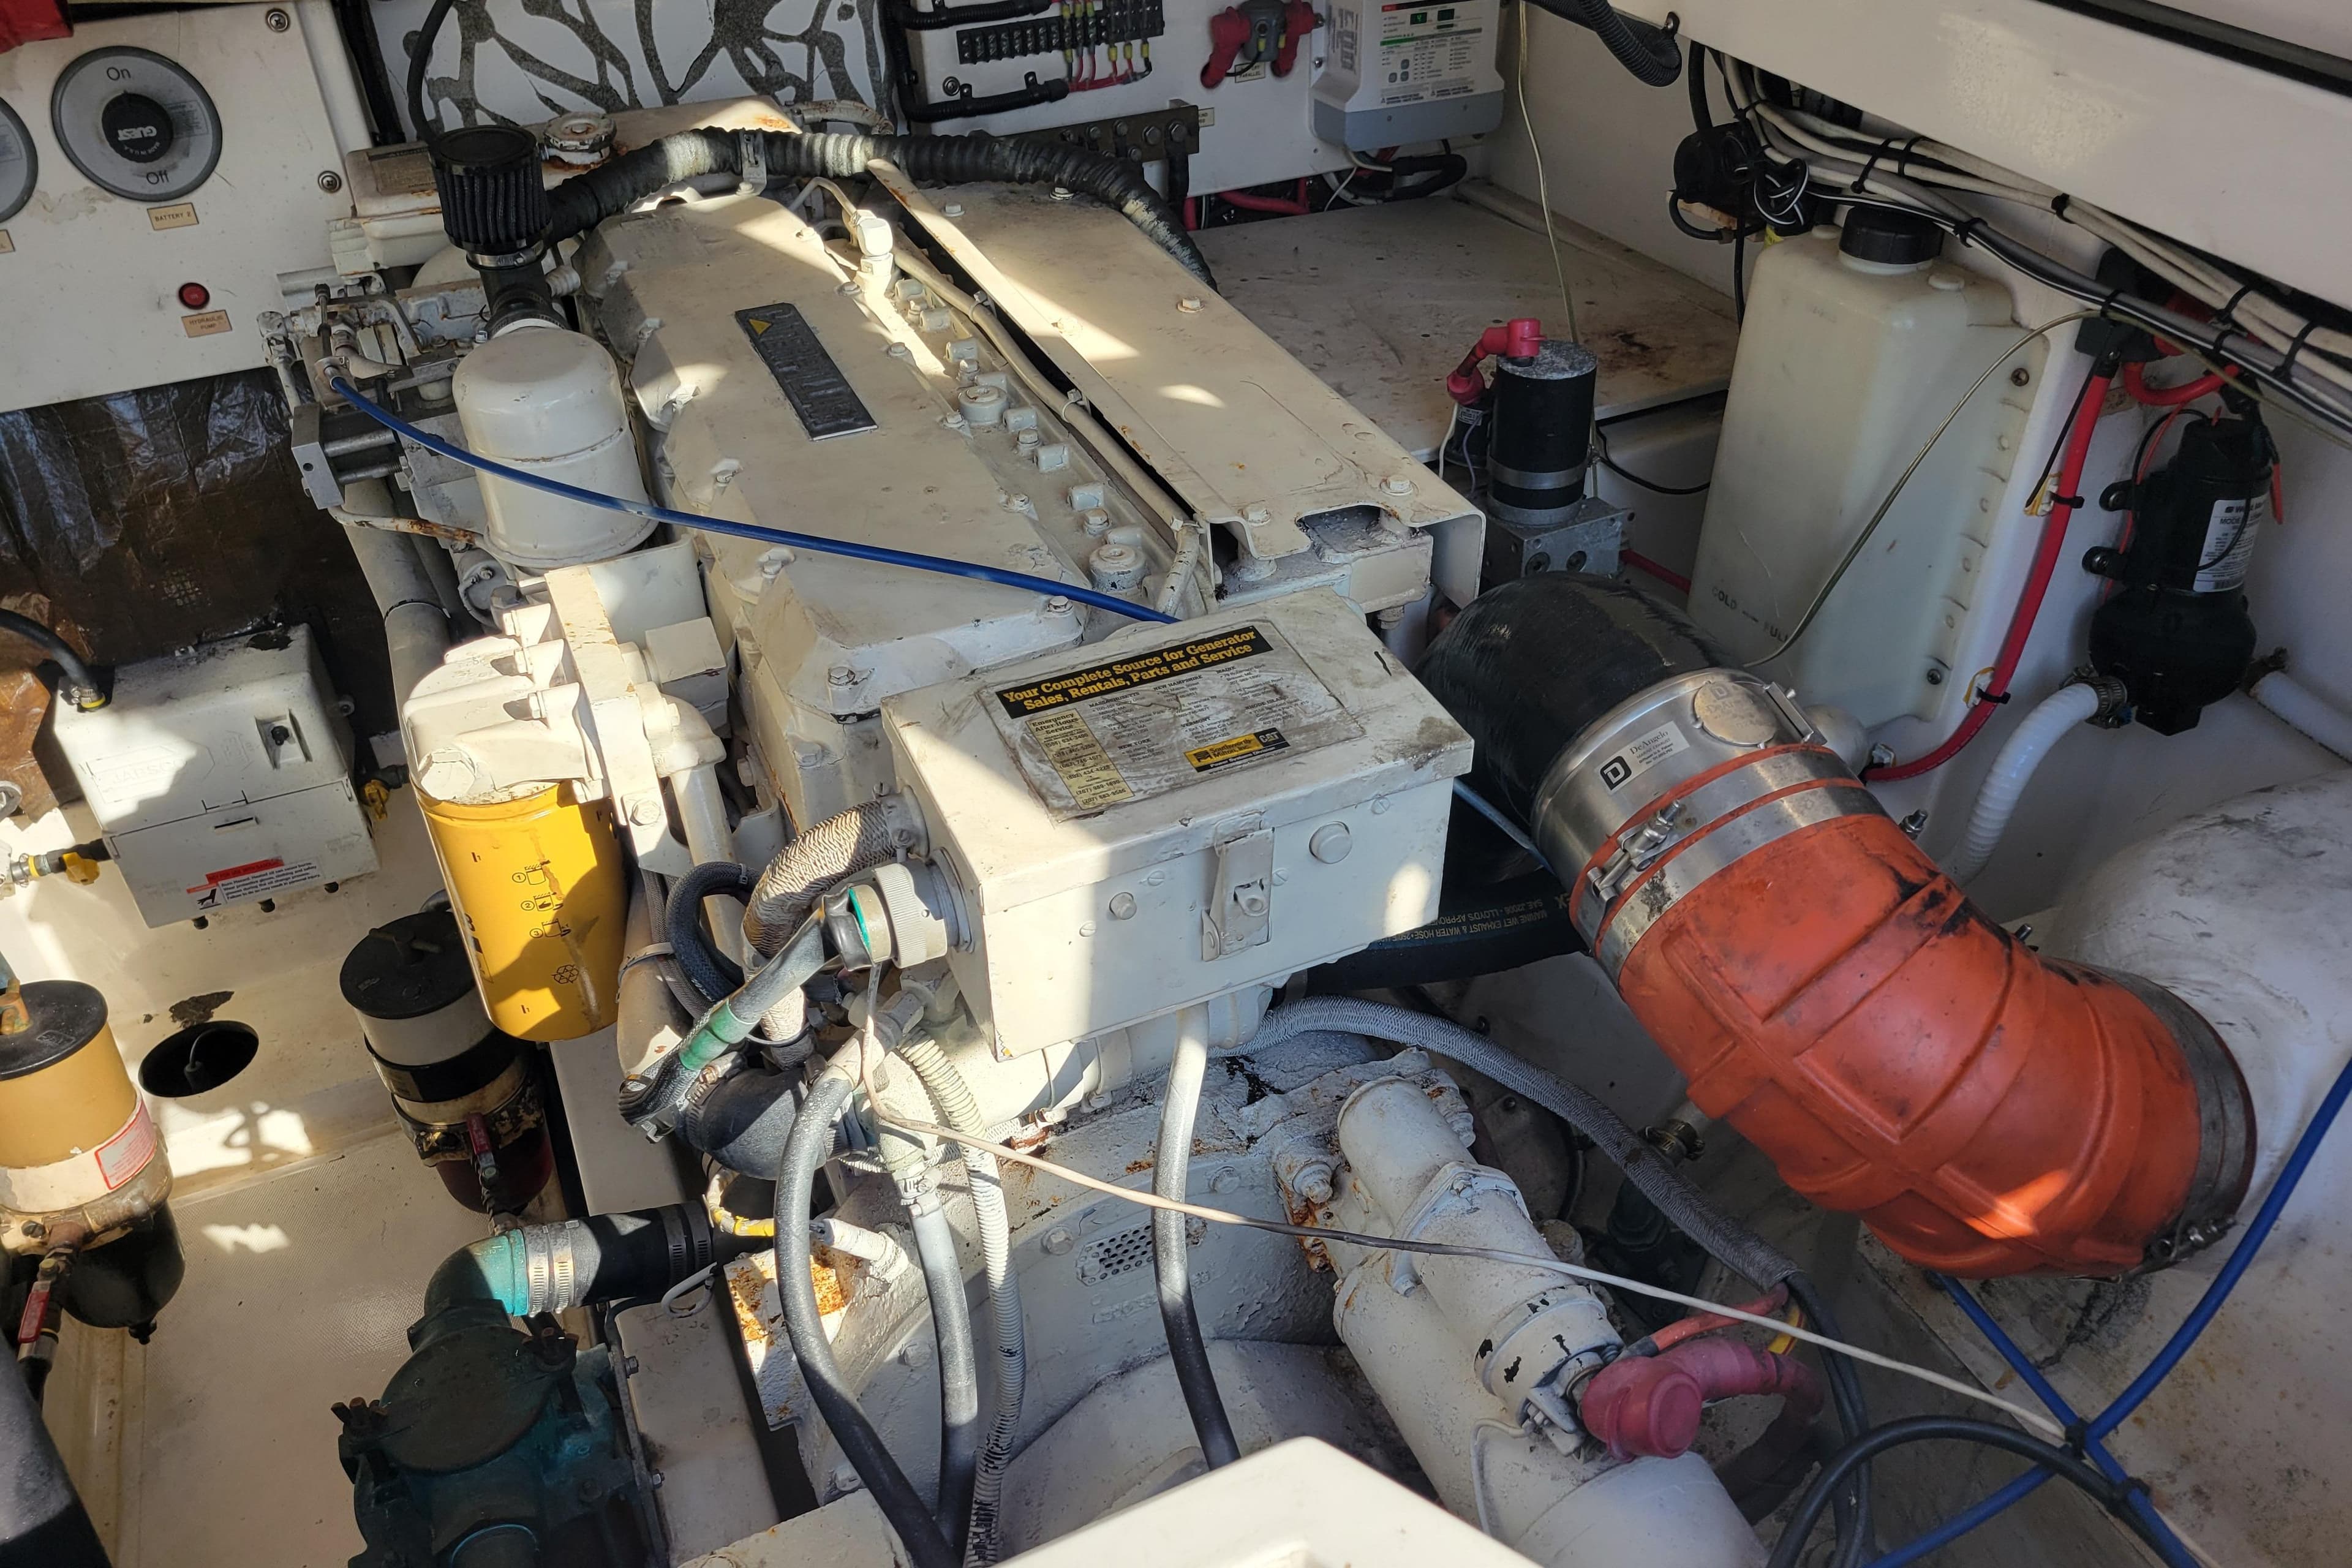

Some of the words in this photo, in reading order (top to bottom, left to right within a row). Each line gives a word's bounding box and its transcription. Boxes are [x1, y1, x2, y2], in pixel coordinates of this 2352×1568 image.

[107, 67, 131, 80] On
[118, 126, 157, 141] GUEST
[146, 170, 168, 184] Off
[155, 213, 184, 222] BATTERY
[189, 315, 224, 325] HYDRAULIC
[1712, 586, 1737, 610] COLD
[1004, 688, 1039, 702] Your
[1041, 670, 1112, 692] Complete
[1113, 657, 1162, 674] Source
[1163, 650, 1185, 661] for
[1186, 631, 1256, 654] Generator
[1024, 694, 1068, 709] Sales,
[1068, 678, 1130, 698] Rentals,
[1129, 667, 1169, 682] Parts
[1172, 657, 1200, 671] and
[1200, 645, 1252, 663] Service
[1167, 674, 1203, 687] HAMPSHIRE
[1088, 692, 1140, 707] MASSACHUSETTS
[1244, 701, 1267, 710] RHODE
[1031, 712, 1075, 728] Emergency
[1034, 716, 1079, 732] After-Hours
[1180, 717, 1211, 728] VERMONT
[1045, 723, 1074, 734] Service
[1259, 732, 1278, 742] CAT
[1629, 730, 1668, 755] DeAngelo
[1209, 758, 1227, 767] Power
[1251, 744, 1275, 755] Division
[1212, 747, 1239, 758] Milton,
[1526, 899, 1544, 911] SAE
[1503, 917, 1519, 927] WET
[1518, 910, 1548, 924] MARINE
[1435, 926, 1460, 937] WATER
[1469, 920, 1501, 933] EXHAUST
